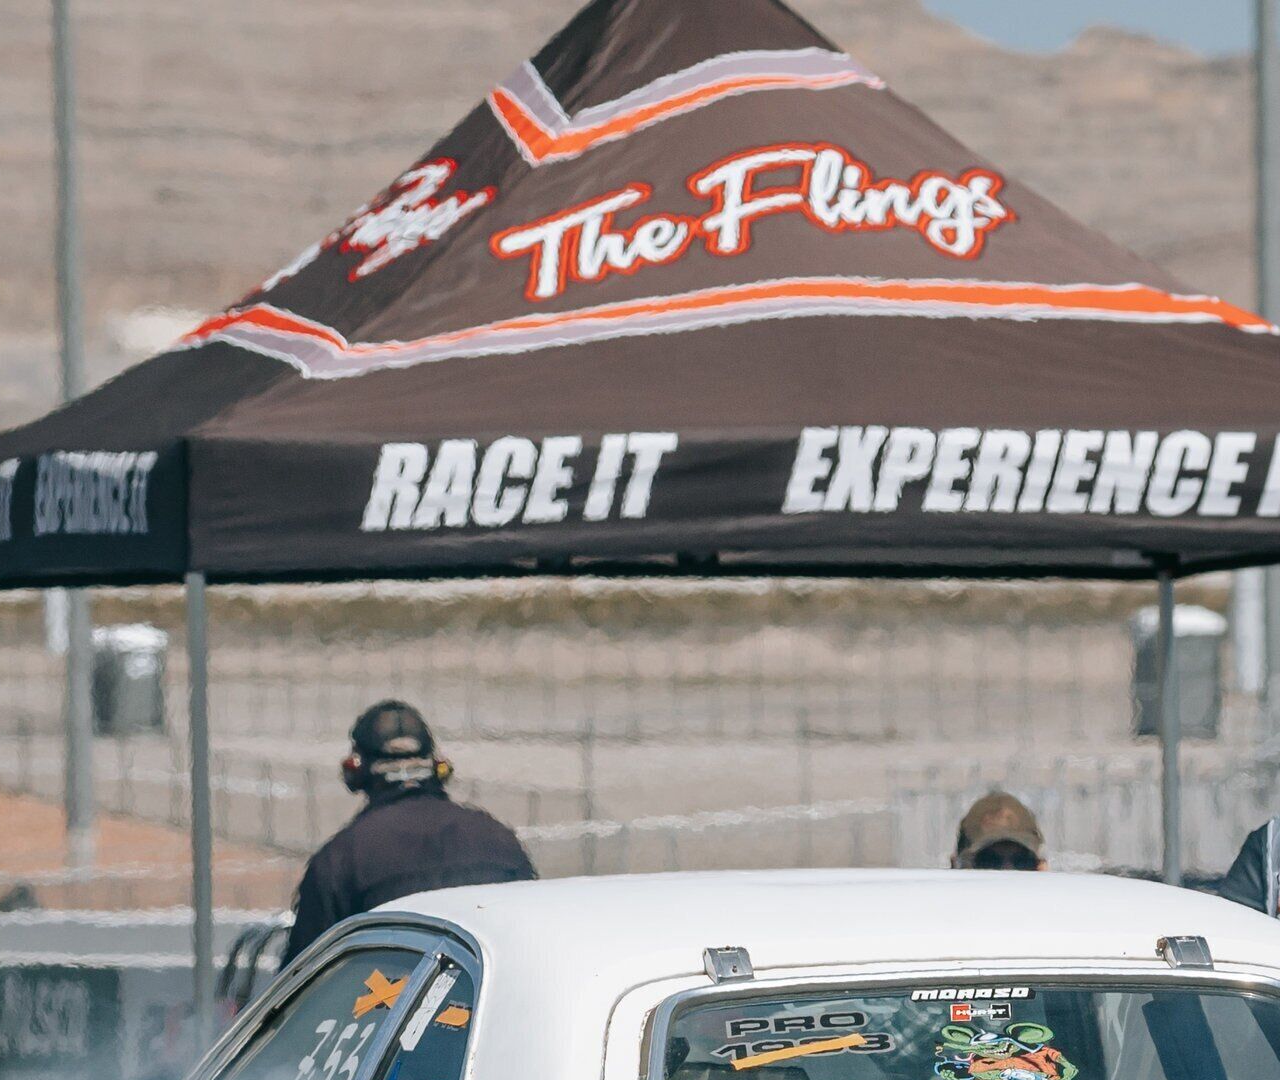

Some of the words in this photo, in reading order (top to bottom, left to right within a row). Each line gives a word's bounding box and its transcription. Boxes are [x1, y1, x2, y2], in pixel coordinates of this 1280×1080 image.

[494, 185, 690, 299] The
[691, 144, 1010, 257] Flings
[360, 436, 582, 531] RACE
[583, 431, 678, 522] IT
[783, 427, 1251, 517] EXPERIENCE
[726, 1011, 869, 1038] PRO
[910, 987, 1030, 1001] MOROSO
